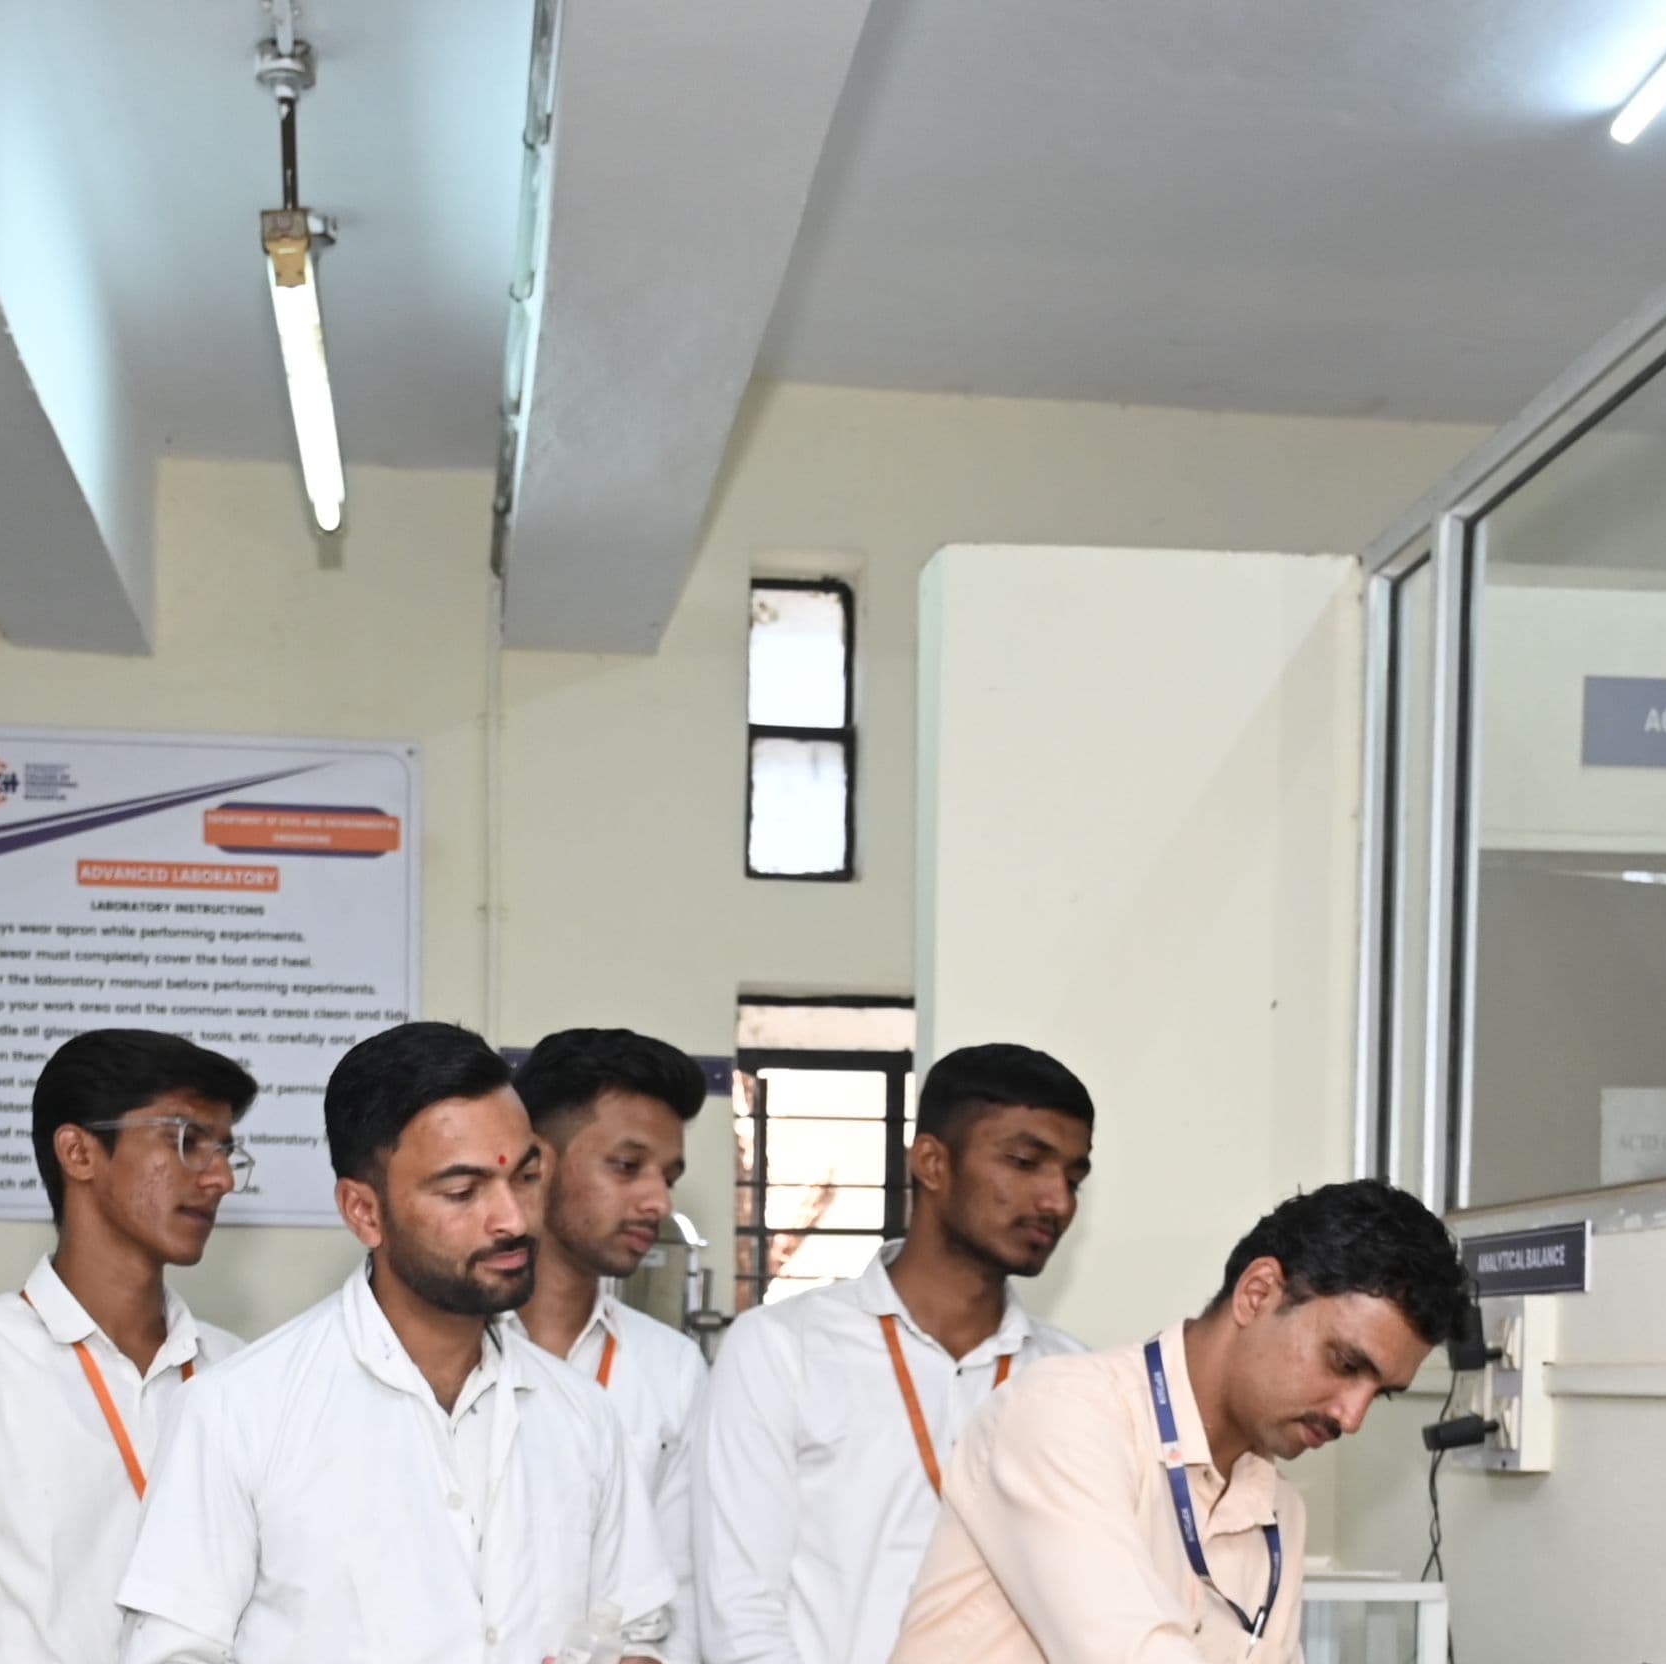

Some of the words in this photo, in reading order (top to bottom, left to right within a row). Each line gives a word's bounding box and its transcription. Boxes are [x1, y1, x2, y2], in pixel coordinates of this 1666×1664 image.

[80, 866, 167, 883] ADVANCED
[172, 868, 277, 885] LABORATORY
[91, 901, 171, 914] LABORATORY
[175, 903, 265, 916] INSTRUCTIONS
[19, 925, 52, 934] wear
[56, 927, 97, 938] apron
[101, 926, 136, 937] while
[140, 927, 215, 943] performing
[36, 949, 71, 961] must
[75, 950, 150, 965] completely
[155, 954, 192, 964] cover
[196, 953, 217, 965] the
[252, 955, 279, 967] and
[8, 973, 30, 985] the
[34, 974, 106, 990] laboratory
[110, 977, 162, 989] manual
[166, 978, 209, 990] before
[213, 979, 288, 996] performing
[9, 1001, 39, 1013] your
[43, 1000, 75, 1012] work
[79, 1003, 111, 1013] area
[115, 1002, 142, 1014] and
[146, 1003, 168, 1015] the
[171, 1006, 232, 1016] common
[236, 1006, 268, 1018] work
[272, 1009, 309, 1019] areas
[313, 1009, 351, 1020] clean
[354, 1010, 380, 1021] and
[23, 1025, 40, 1037] all
[267, 1032, 326, 1047] carefully
[330, 1034, 356, 1045] and
[250, 1133, 318, 1147] laboratory
